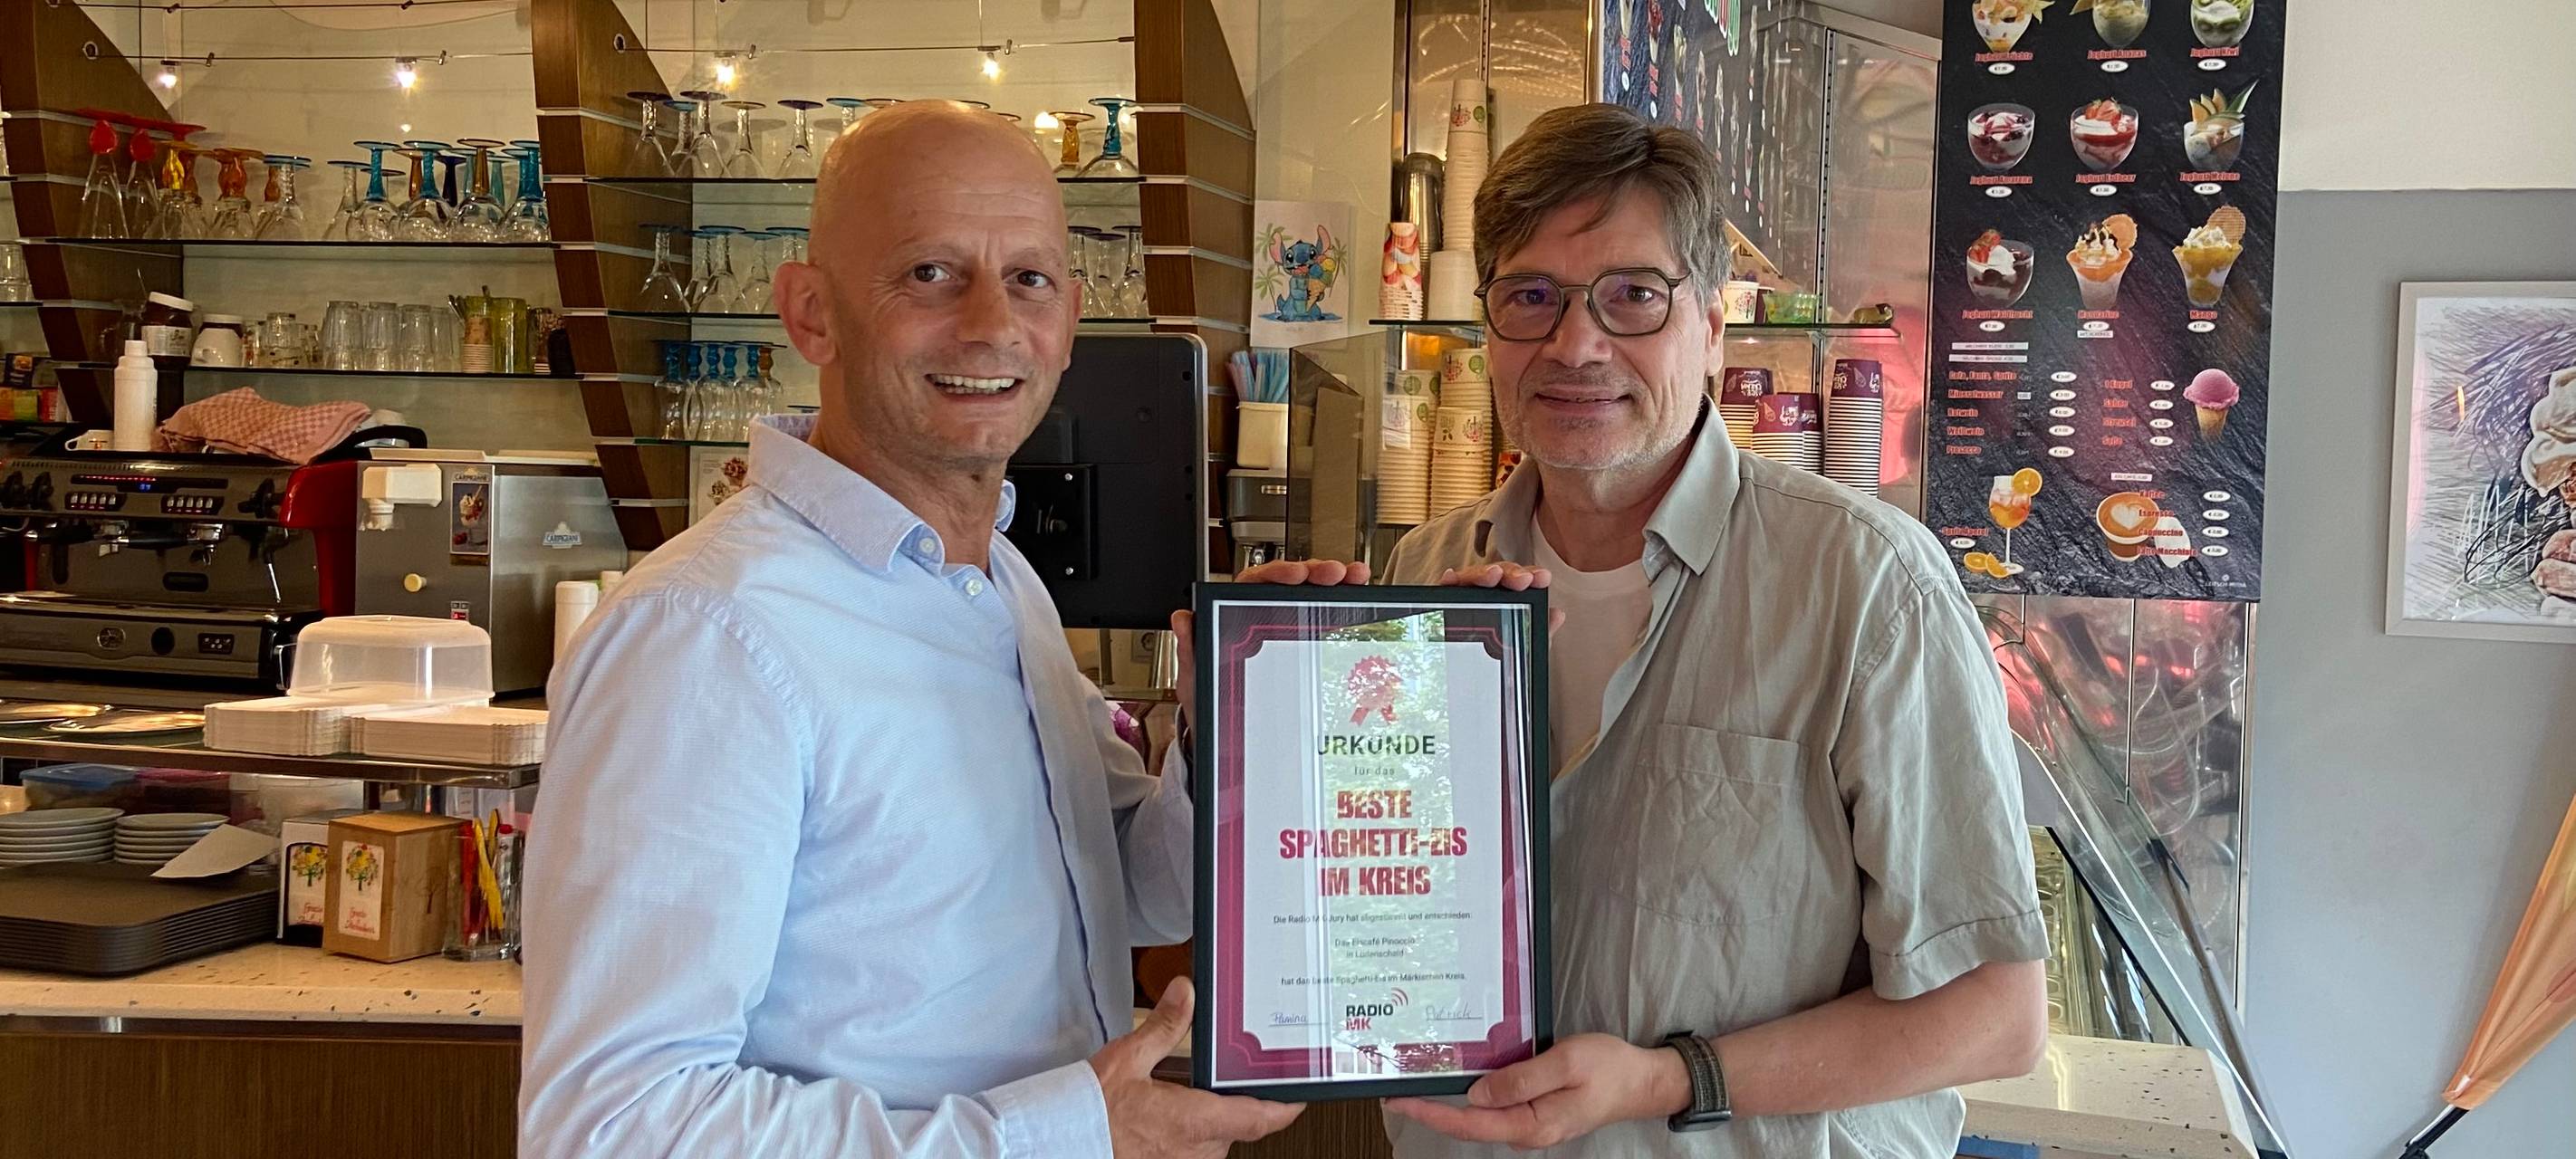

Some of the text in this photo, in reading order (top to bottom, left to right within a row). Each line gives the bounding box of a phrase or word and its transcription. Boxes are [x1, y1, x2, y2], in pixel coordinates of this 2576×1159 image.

[2189, 311, 2218, 320] Mango
[1948, 389, 2004, 399] Mineralwasser
[546, 534, 580, 542] CARPIGIANI
[2139, 528, 2184, 537] Cappuccino
[1317, 734, 1436, 756] URKUNDE
[1375, 766, 1395, 776] das
[1337, 790, 1412, 819] BESTE
[1279, 827, 1467, 858] SPAGHETTI-EIS
[1321, 866, 1431, 896] IM KREIS
[1273, 915, 1286, 924] Die
[1288, 914, 1311, 924] Radio
[1346, 914, 1359, 922] hat
[1408, 913, 1423, 921] und
[1281, 977, 1294, 985] hat
[1296, 977, 1311, 985] das
[1388, 974, 1398, 982] im
[1345, 1003, 1394, 1018] RADIO
[1345, 1017, 1372, 1031] MK
